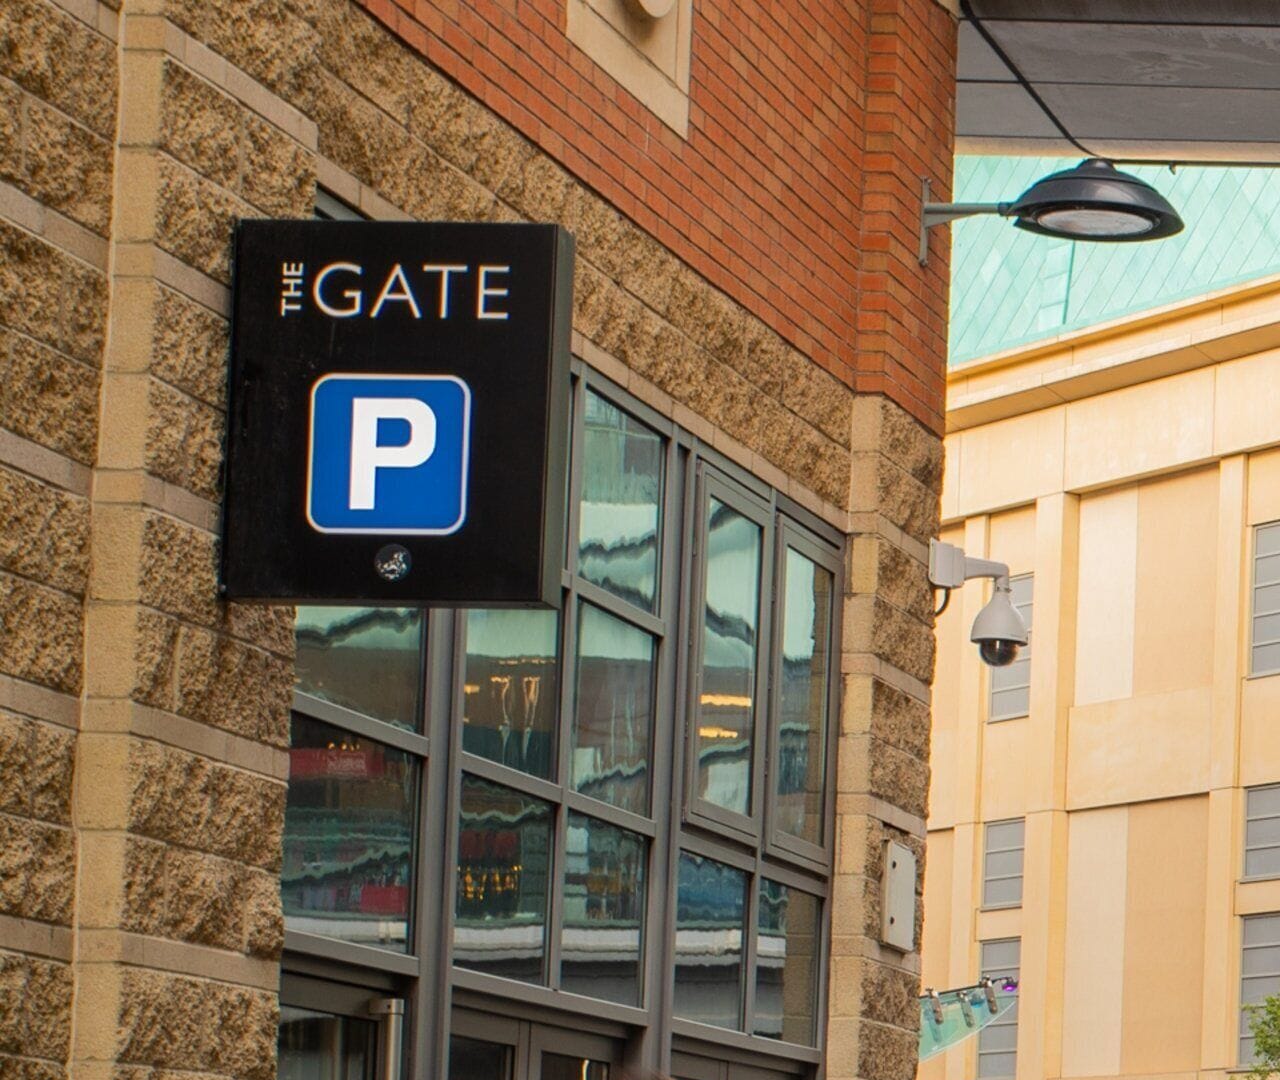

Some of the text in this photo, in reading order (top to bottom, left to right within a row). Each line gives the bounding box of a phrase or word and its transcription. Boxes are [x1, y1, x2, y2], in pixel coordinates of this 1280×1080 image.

[281, 261, 510, 320] THE GATE
[348, 396, 437, 511] P
